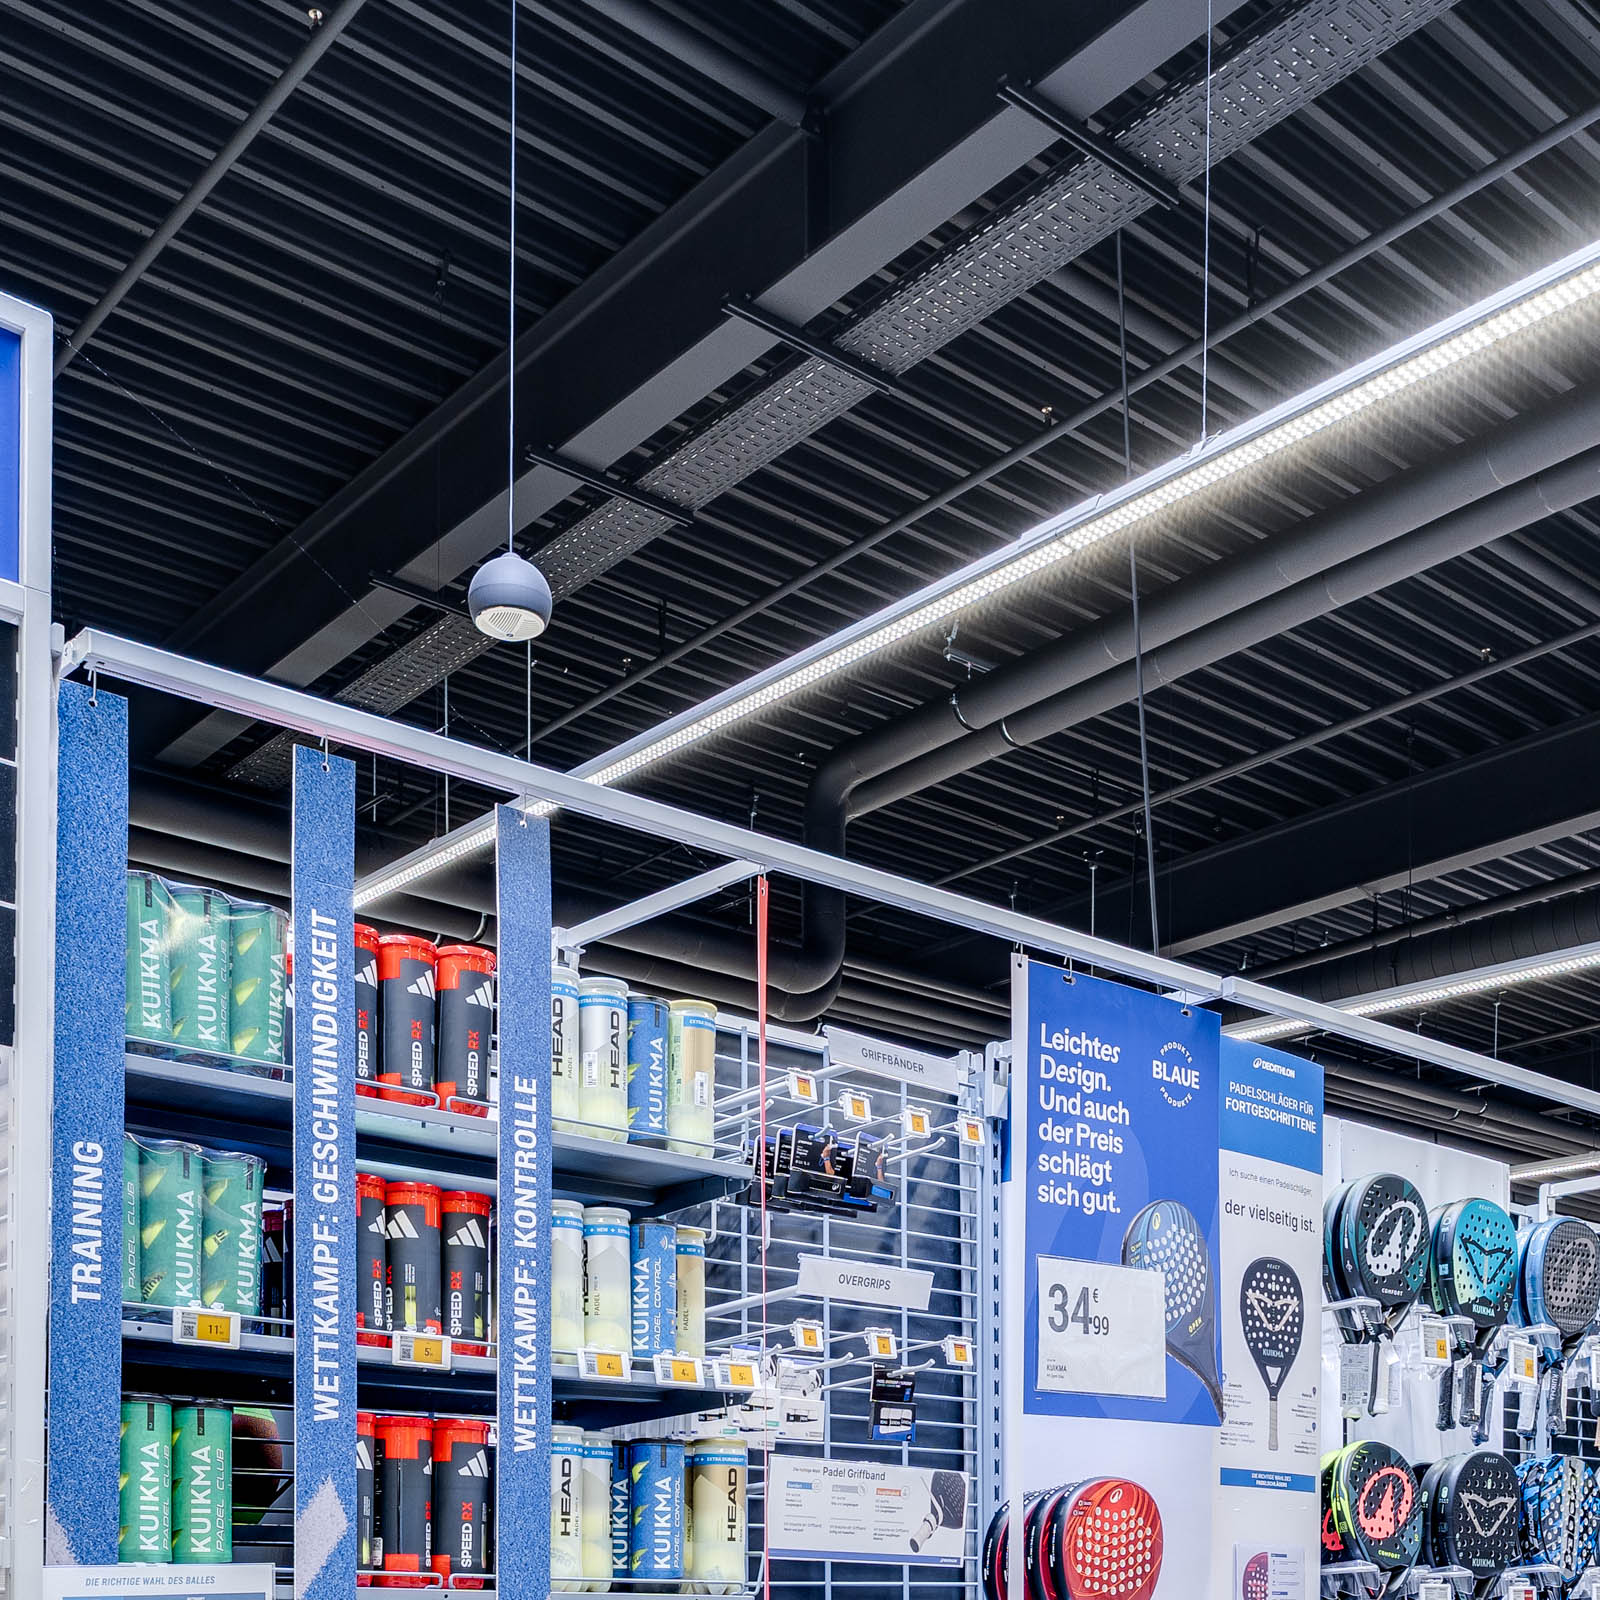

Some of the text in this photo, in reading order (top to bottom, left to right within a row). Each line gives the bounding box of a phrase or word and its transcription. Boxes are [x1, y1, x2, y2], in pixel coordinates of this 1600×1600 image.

[141, 918, 163, 1030] KUIKMA
[198, 934, 217, 1043] KUIKMA
[358, 1009, 369, 1077] SPEED RX
[411, 1019, 423, 1088] SPEED RX
[467, 1029, 479, 1097] SPEED RX
[552, 998, 564, 1077] HEAD
[611, 1010, 621, 1089] HEAD
[861, 1047, 925, 1074] GRIFFBÄNDER
[1040, 1023, 1120, 1064] Leichtes
[1160, 1040, 1193, 1064] PRODUKTE
[1262, 1060, 1296, 1079] DECATHLON
[648, 1037, 664, 1131] KUIKMA
[1040, 1056, 1112, 1093] Design.
[1040, 1085, 1130, 1127] Und auch
[1152, 1059, 1200, 1091] BLAUE
[1160, 1086, 1193, 1108] PRODUKTE
[1229, 1080, 1314, 1116] PADELSCHLÄGER FÜR
[1038, 1120, 1124, 1155] der Preis
[1225, 1097, 1317, 1134] FORTGESCHRITTENE
[310, 908, 340, 1424] WETTKAMPF: GESCHWINDIGKEIT
[1038, 1152, 1113, 1186] schlägt
[1038, 1183, 1121, 1215] sich gut.
[1229, 1167, 1239, 1177] Ich
[1240, 1170, 1257, 1182] suche
[1258, 1175, 1275, 1185] einen
[70, 1141, 102, 1304] TRAINING
[127, 1182, 138, 1289] PADEL CLUB
[175, 1189, 195, 1299] KUIKMA
[1225, 1199, 1316, 1233] der vielseitig ist.
[237, 1200, 258, 1307] KUIKMA
[513, 1077, 538, 1454] WETTKAMPF: KONTROLLE
[838, 1273, 891, 1290] OVERGRIPS
[373, 1258, 384, 1327] SPEED RX
[451, 1271, 463, 1336] SPEED RX
[633, 1257, 650, 1351] KUIKMA
[653, 1257, 662, 1349] PADEL CONTROL
[1188, 1317, 1203, 1334] OPEN
[1381, 1287, 1404, 1297] COMFORT
[823, 1466, 886, 1481] Padel Griffband
[1484, 1456, 1499, 1464] REACT
[140, 1440, 160, 1552] KUIKMA
[162, 1444, 171, 1551] PADEL CLUB
[191, 1443, 212, 1553] KUIKMA
[215, 1448, 225, 1553] PADEL CLUB
[560, 1458, 572, 1537] HEAD
[654, 1476, 672, 1570] KUIKMA
[727, 1467, 738, 1542] HEAD
[461, 1502, 473, 1568] SPEED RX
[1378, 1549, 1401, 1560] COMFORT
[85, 1575, 216, 1587] DIE RICHTIGE WAHL DES BALLES
